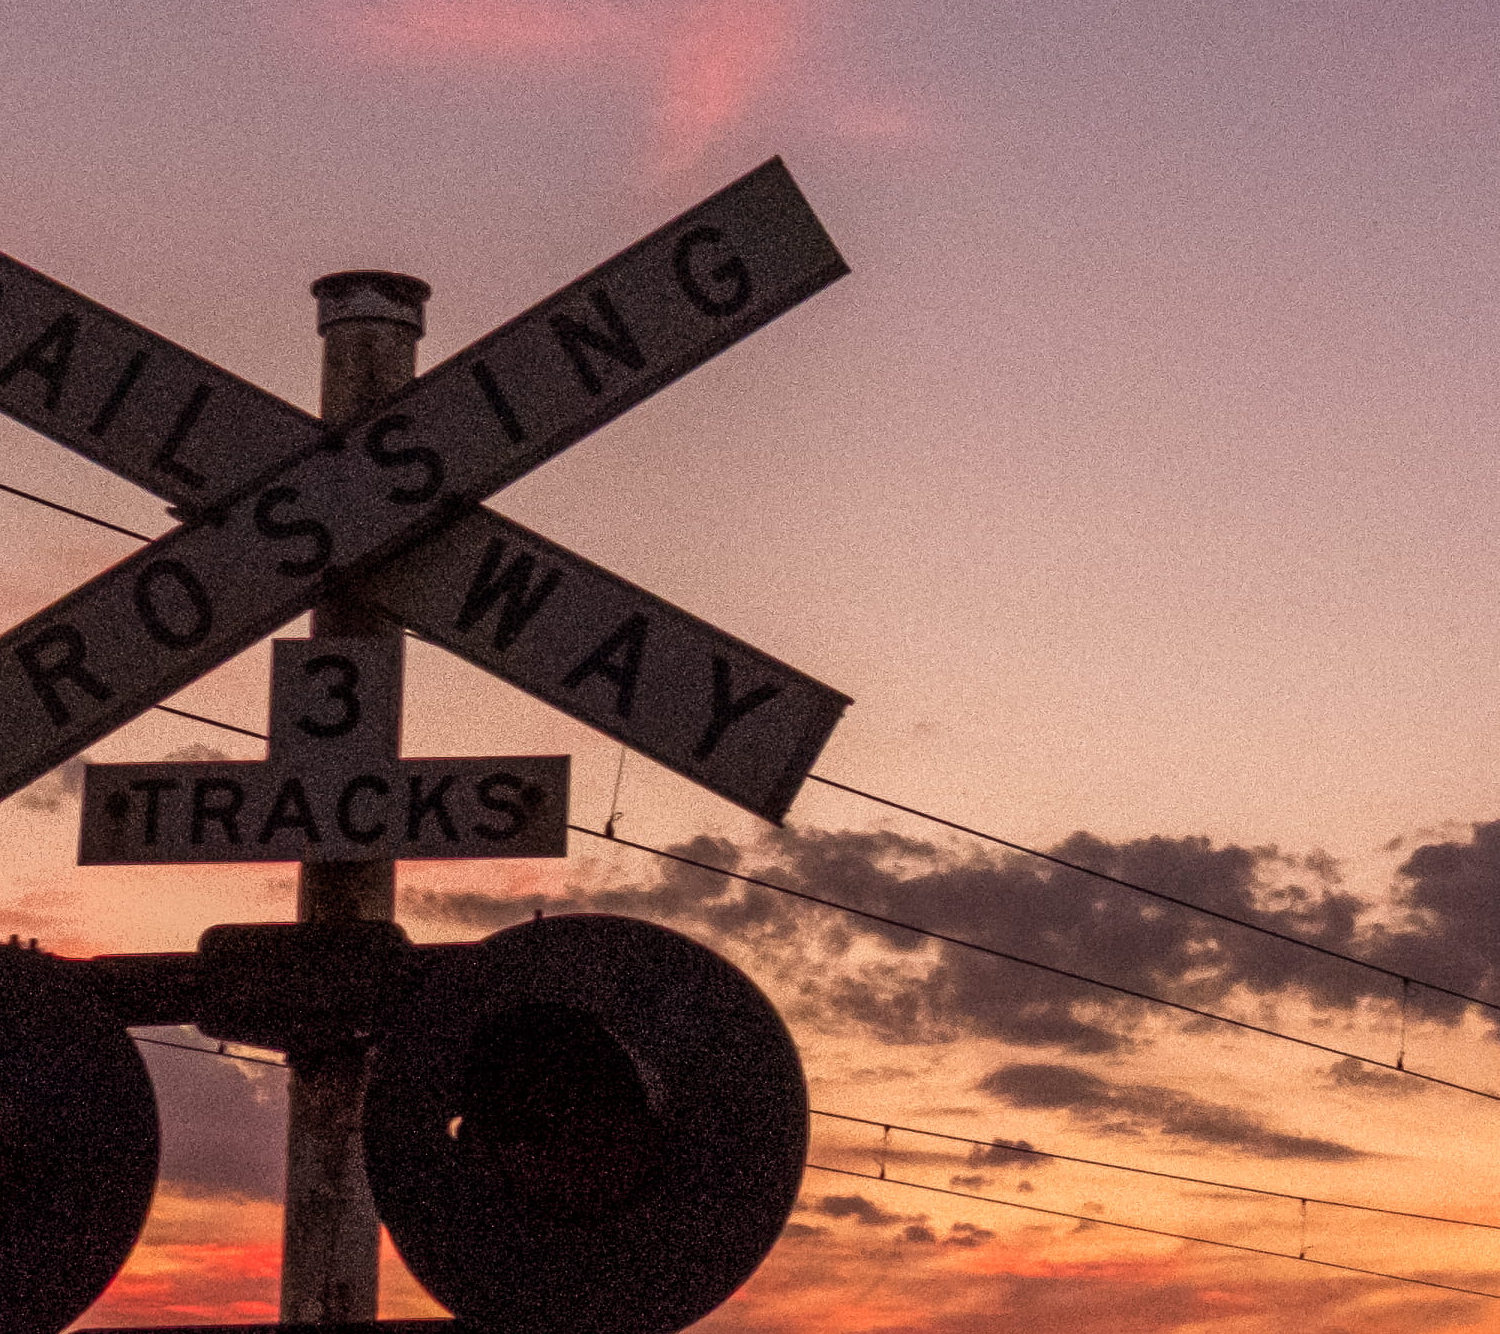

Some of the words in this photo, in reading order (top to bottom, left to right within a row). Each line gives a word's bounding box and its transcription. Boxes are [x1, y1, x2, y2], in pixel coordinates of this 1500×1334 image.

[456, 538, 778, 761] WAY
[297, 655, 362, 738] 3
[129, 772, 531, 845] TRACKS
